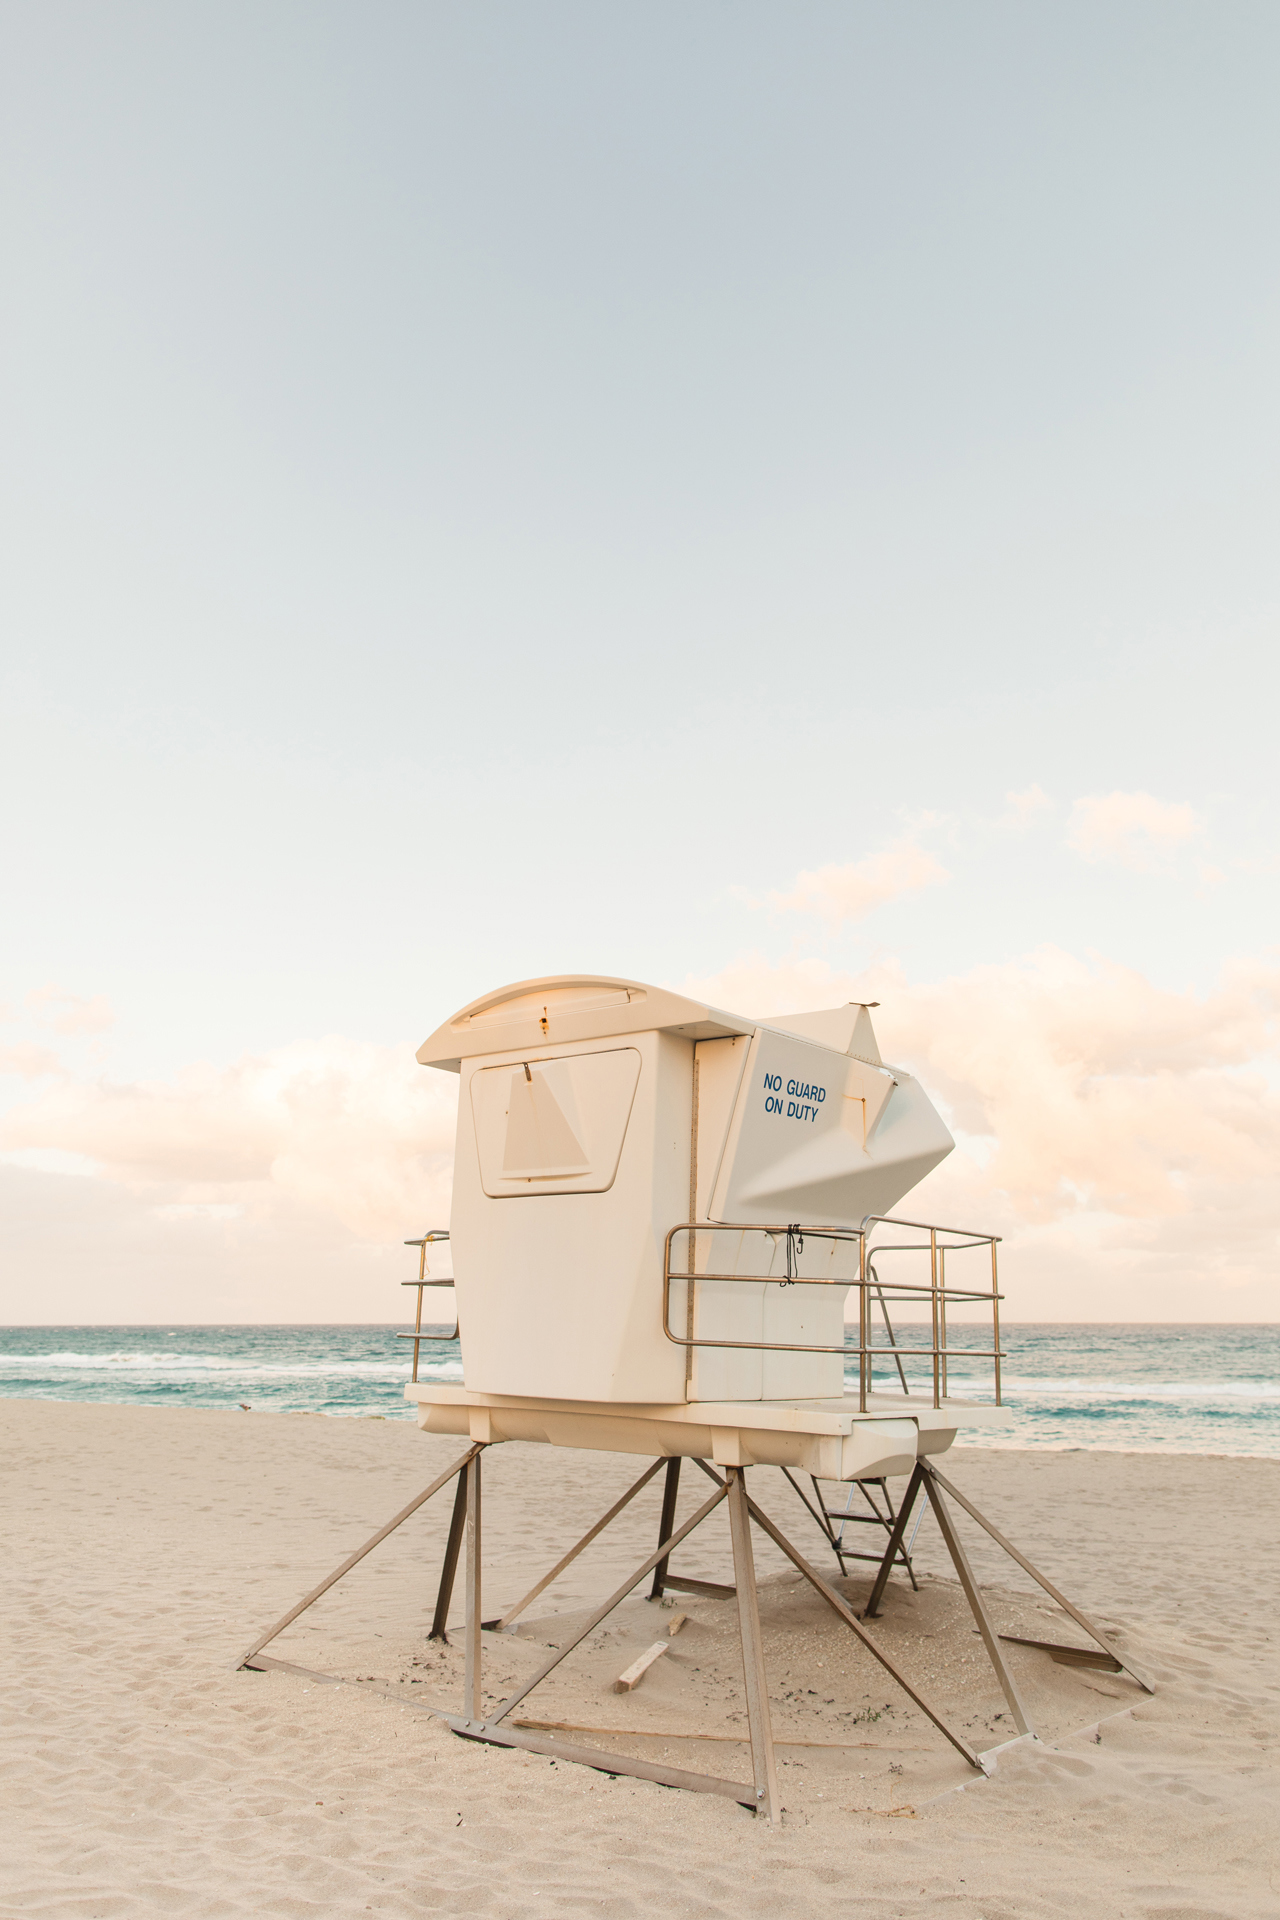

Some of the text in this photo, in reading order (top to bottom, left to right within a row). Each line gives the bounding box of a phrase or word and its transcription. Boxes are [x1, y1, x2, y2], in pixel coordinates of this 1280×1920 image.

[763, 1073, 826, 1103] NO GUARD
[765, 1096, 819, 1122] ON DUTY
